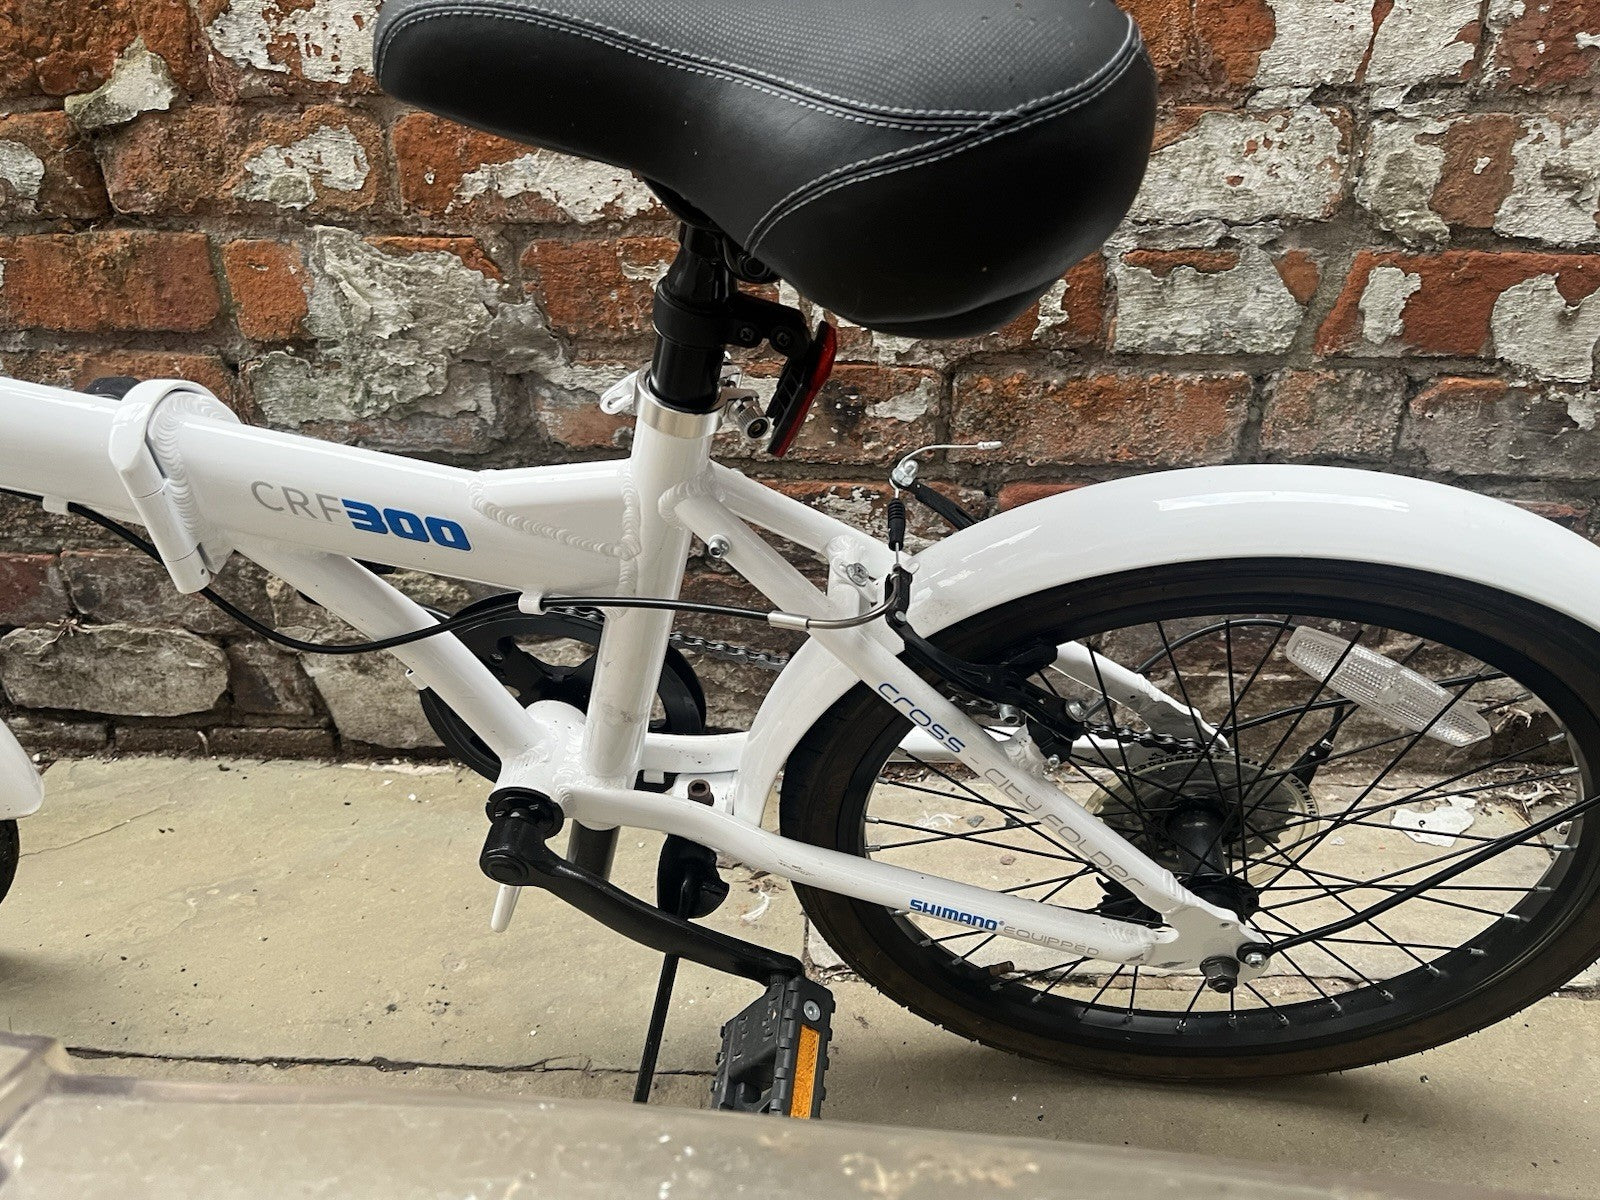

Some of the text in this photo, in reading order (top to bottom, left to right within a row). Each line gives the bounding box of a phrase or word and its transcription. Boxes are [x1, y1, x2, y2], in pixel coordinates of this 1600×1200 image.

[251, 480, 472, 551] CRF300
[878, 682, 966, 754] CROSS
[1003, 926, 1099, 956] EQUIPPED
